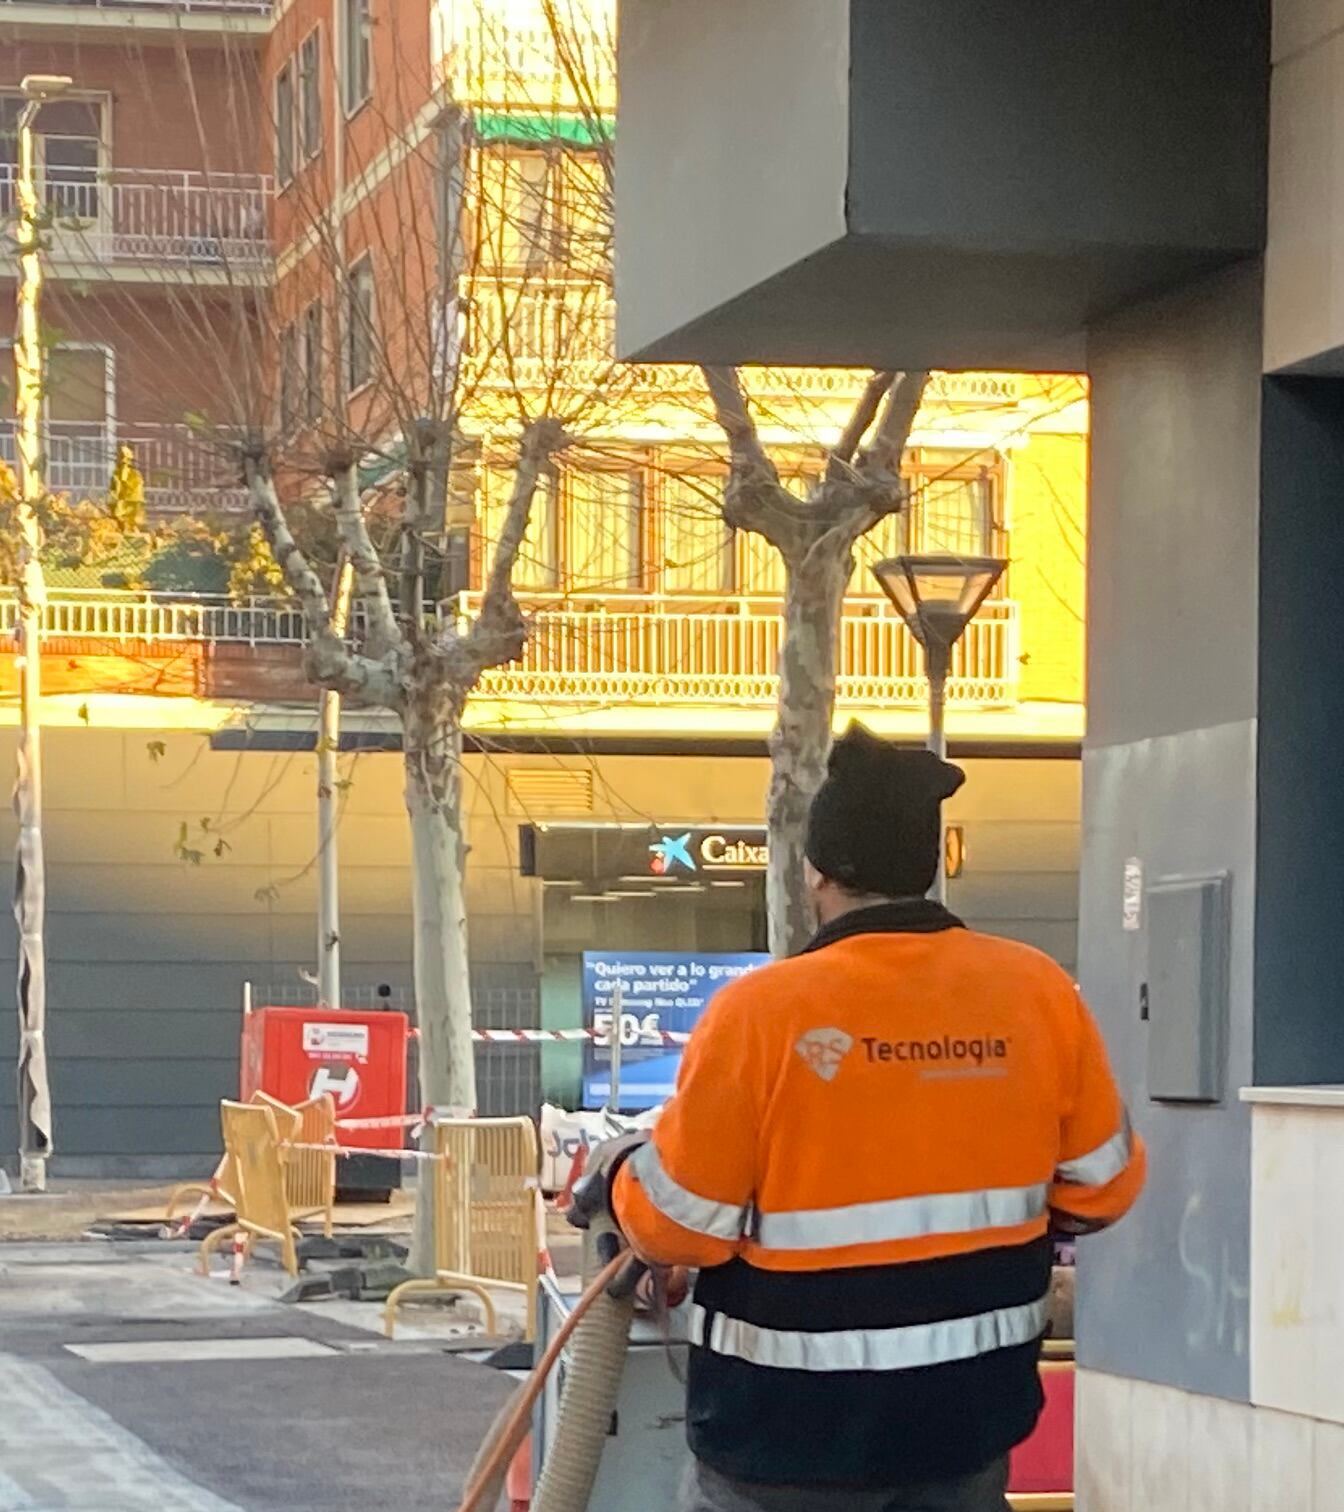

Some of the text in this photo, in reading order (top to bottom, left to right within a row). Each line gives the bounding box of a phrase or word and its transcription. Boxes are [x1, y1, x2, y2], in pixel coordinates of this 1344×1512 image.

[649, 965, 674, 976] ver
[677, 965, 688, 976] a
[690, 962, 706, 976] lo
